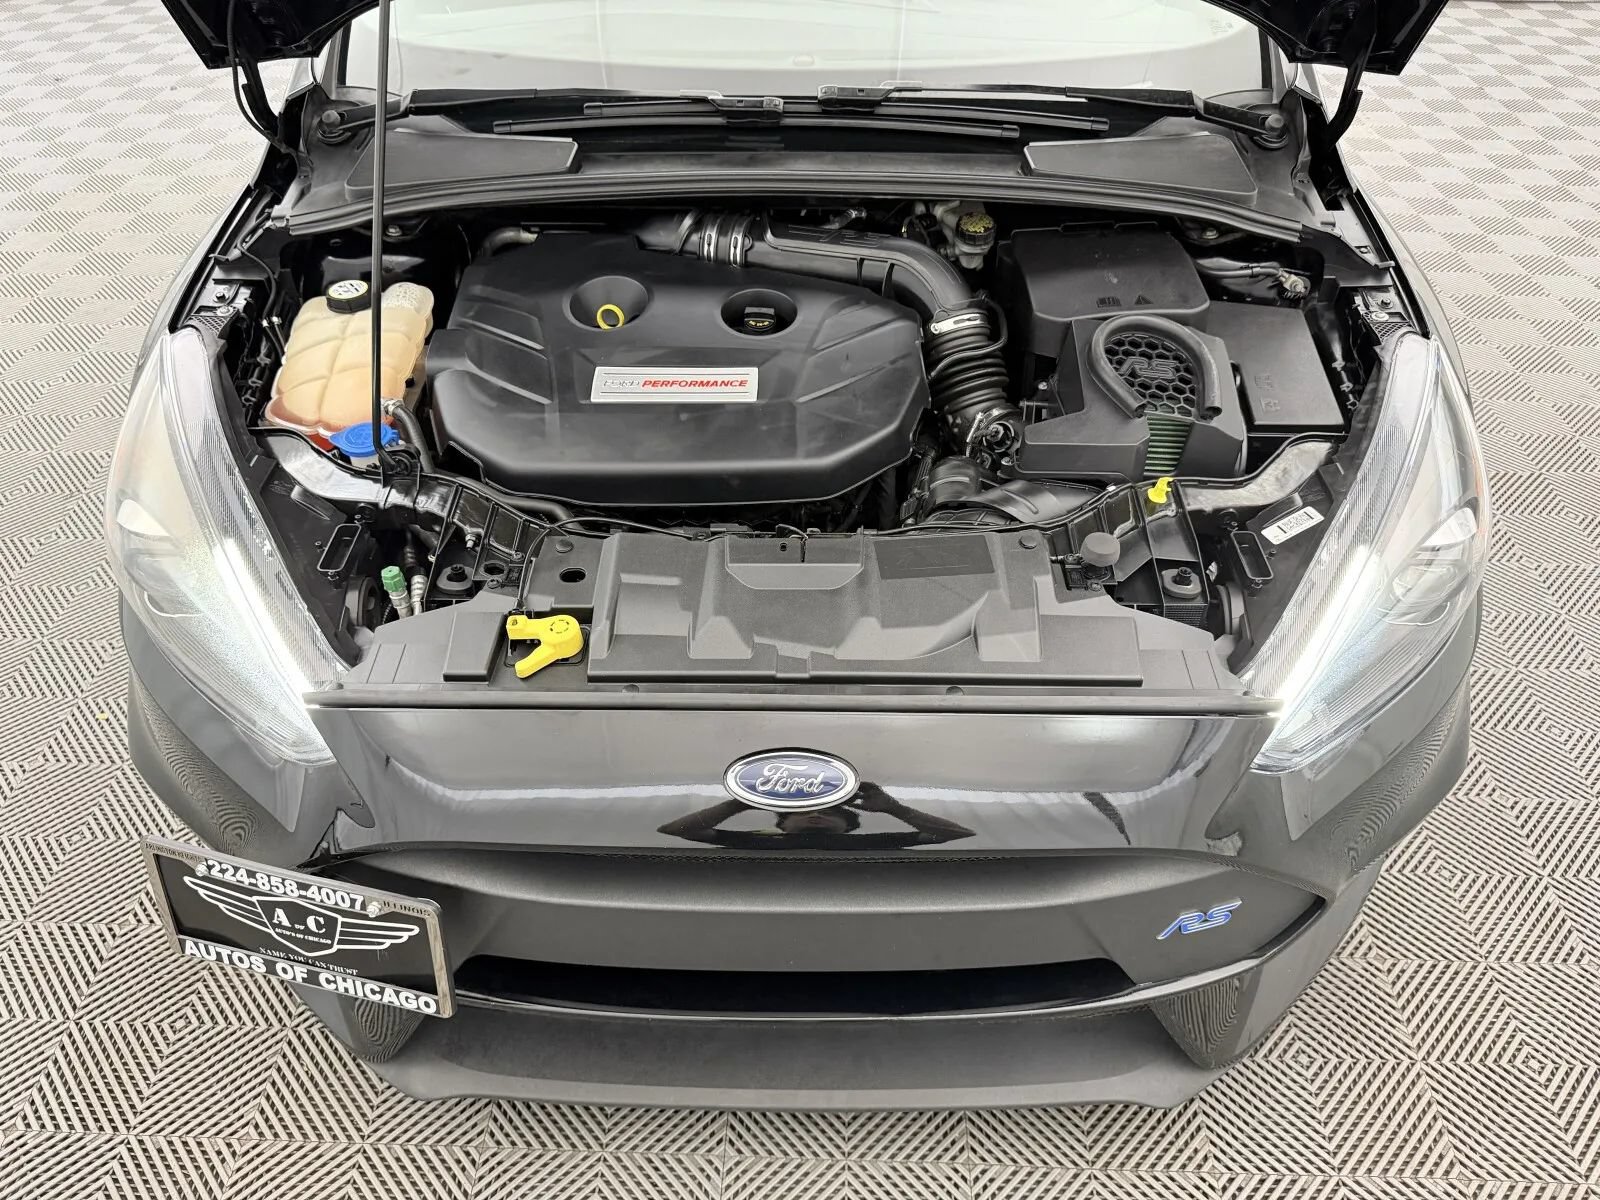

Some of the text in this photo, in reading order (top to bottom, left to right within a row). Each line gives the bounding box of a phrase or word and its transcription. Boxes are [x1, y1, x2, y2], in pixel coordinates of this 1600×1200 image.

[603, 379, 749, 388] FORD PERFORMANCE
[755, 763, 825, 793] Ford
[206, 859, 366, 911] 224-858-4007
[272, 908, 292, 927] A
[306, 915, 326, 933] C
[383, 900, 431, 917] ILLINOIS
[1156, 898, 1242, 940] RS
[305, 935, 332, 945] CHICAGO
[259, 946, 358, 976] NAME YOU CAN TRUST
[184, 939, 437, 1015] AUTOS OF CHICAGO
